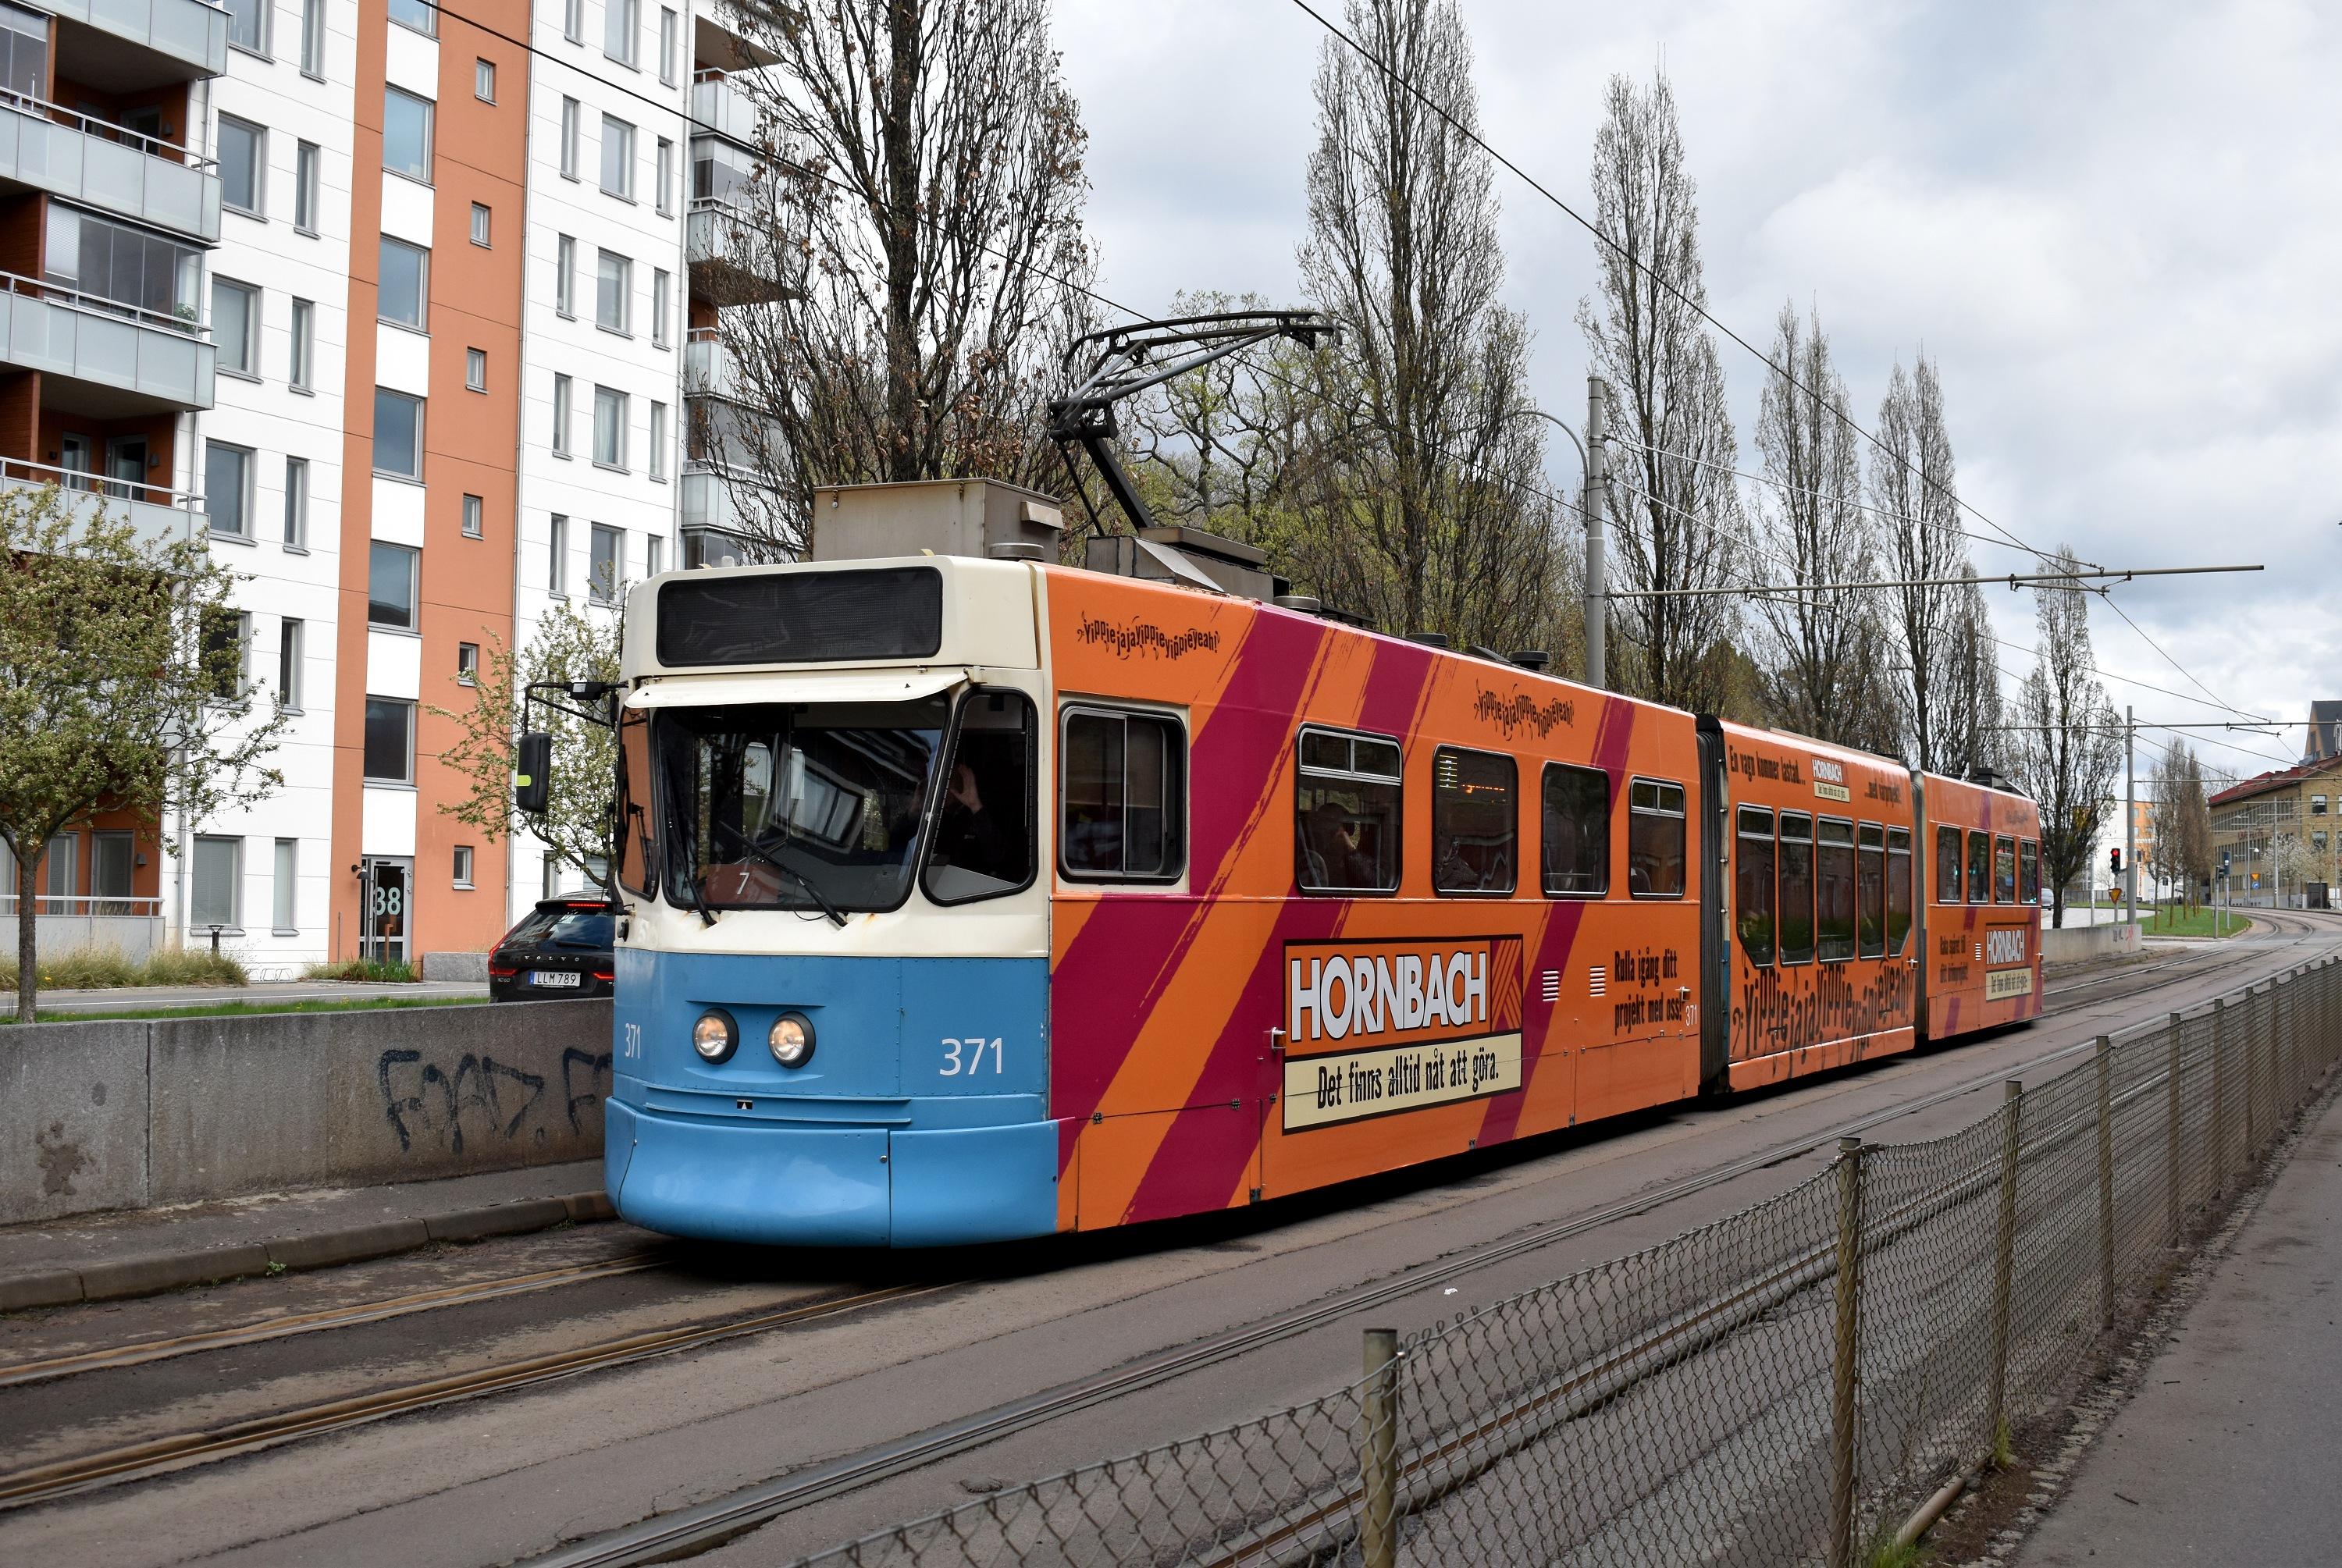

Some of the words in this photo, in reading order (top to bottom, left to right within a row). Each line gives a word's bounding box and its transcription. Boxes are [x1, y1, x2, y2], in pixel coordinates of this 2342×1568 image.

[1740, 753, 1755, 782] vagn
[1756, 750, 1779, 780] kommer
[1812, 759, 1842, 783] HORNBACH
[376, 886, 401, 916] 38
[737, 872, 750, 895] 7
[1986, 930, 2025, 965] HORNBACH
[537, 972, 556, 985] LLM
[557, 974, 576, 985] 789
[1614, 950, 1635, 983] Rulla
[1638, 946, 1659, 988] igång
[1663, 948, 1677, 979] ditt
[1290, 950, 1487, 1041] HORNBACH
[1614, 994, 1645, 1036] projekt
[1648, 992, 1664, 1023] med
[1666, 997, 1682, 1022] oss!
[1685, 1004, 1697, 1026] 371
[625, 1022, 640, 1059] 371
[939, 1037, 1002, 1076] 371
[1318, 1065, 1343, 1109] Det
[1349, 1061, 1382, 1103] finns
[1388, 1053, 1420, 1097] alltid
[1425, 1047, 1444, 1090] nåt
[1450, 1049, 1468, 1087] att
[1472, 1046, 1499, 1093] göra.
